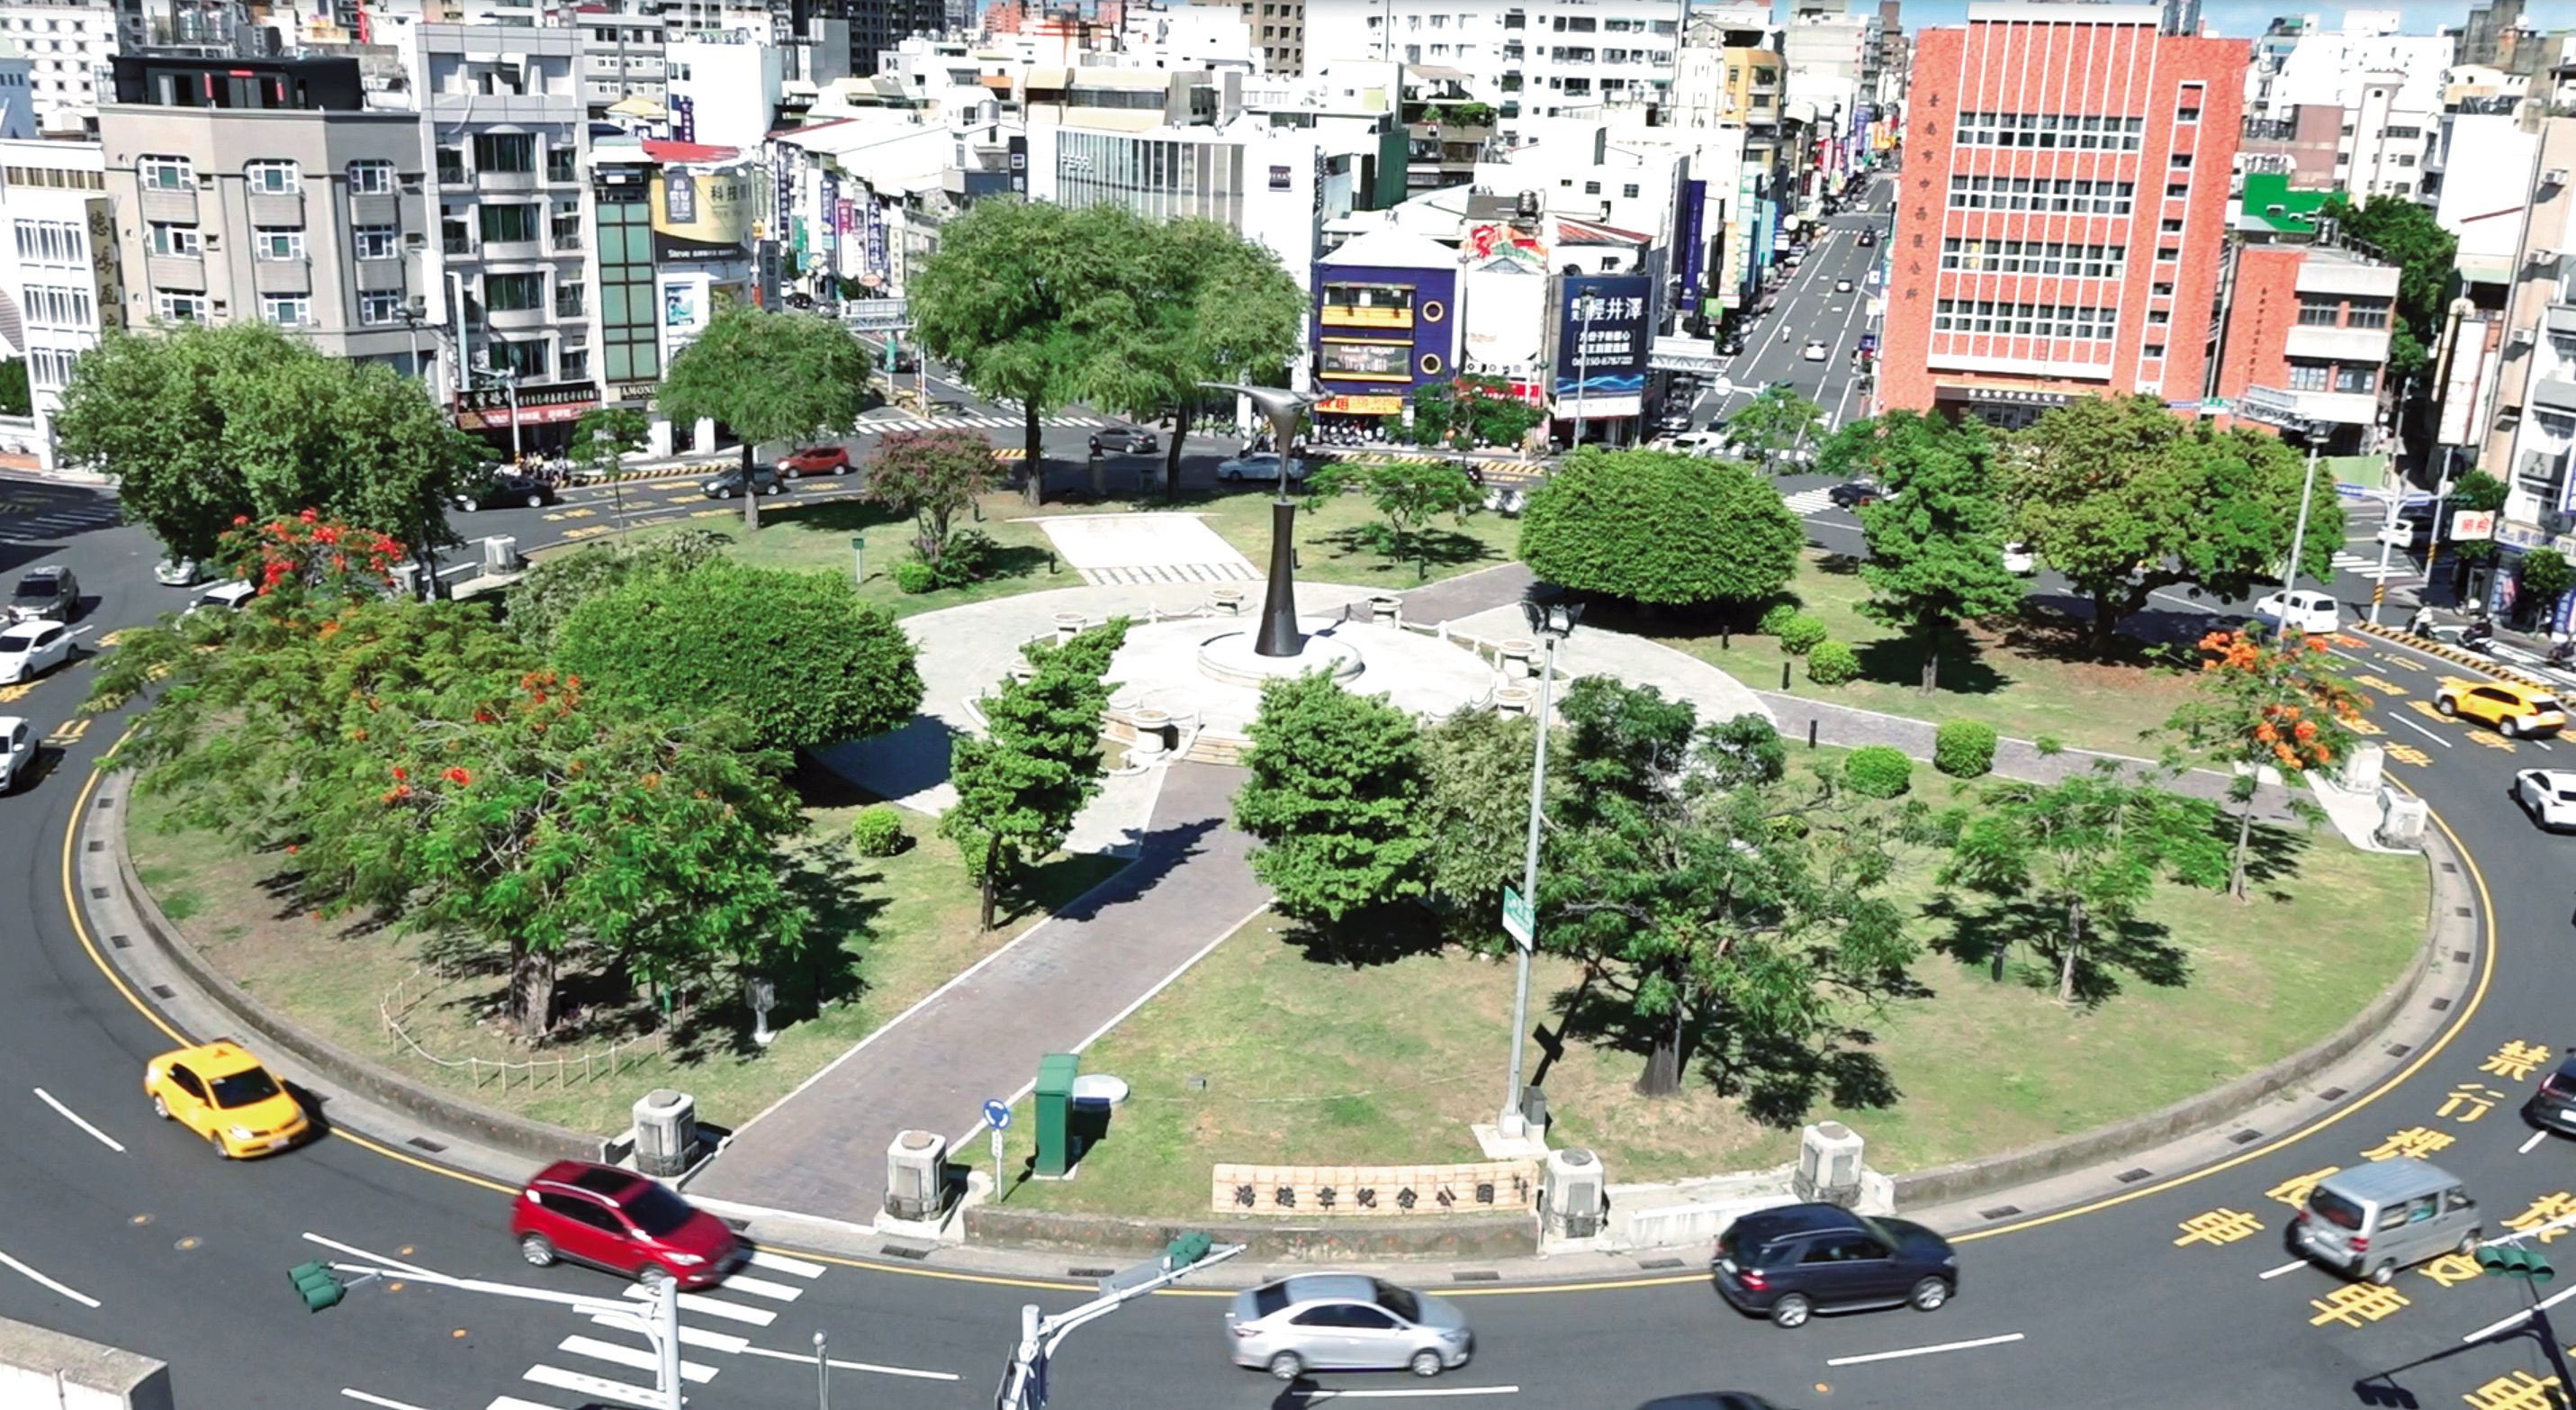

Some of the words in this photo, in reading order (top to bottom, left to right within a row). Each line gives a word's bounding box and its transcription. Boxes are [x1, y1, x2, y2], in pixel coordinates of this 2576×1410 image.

[1234, 1182, 1495, 1211] 湯德章紀念公園
